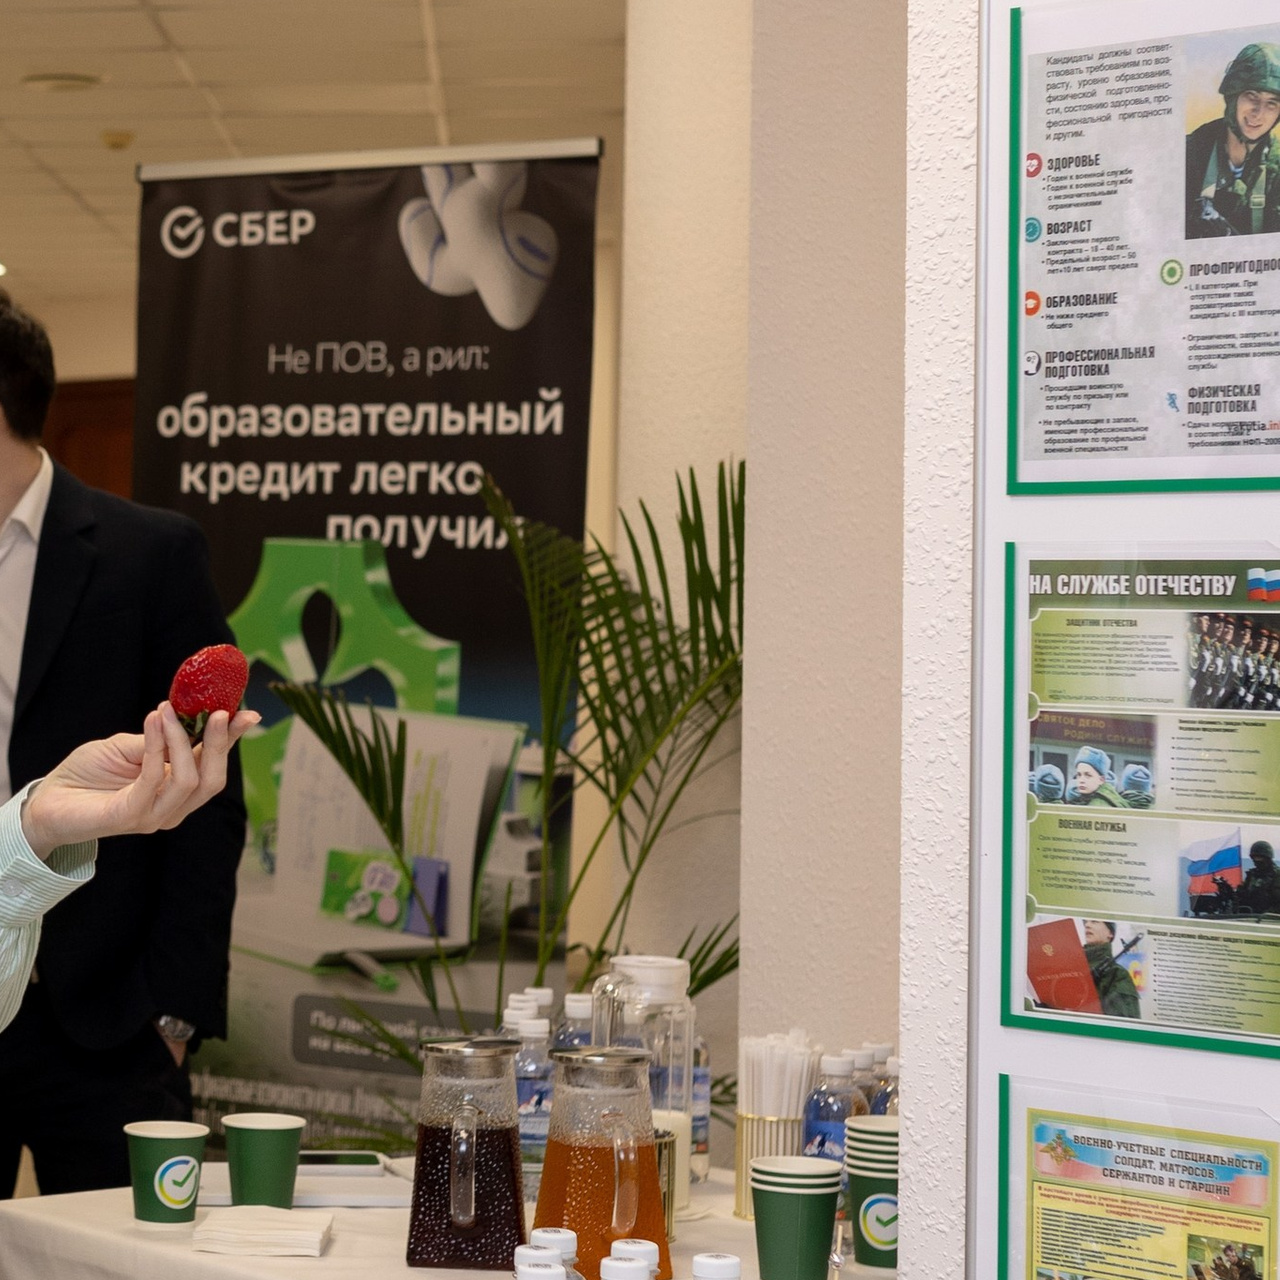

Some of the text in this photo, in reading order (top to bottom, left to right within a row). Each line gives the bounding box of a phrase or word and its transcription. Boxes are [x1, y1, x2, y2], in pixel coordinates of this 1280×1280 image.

[1046, 54, 1093, 65] Кандидаты
[1098, 49, 1132, 60] должны
[1046, 67, 1083, 78] ствовать
[1086, 60, 1140, 74] требованиям
[1154, 56, 1172, 64] воз-
[1078, 76, 1109, 89] уровню
[1046, 82, 1172, 104] физической подготовленно-
[1064, 103, 1108, 113] состоянию
[1154, 94, 1172, 104] про-
[1046, 107, 1172, 129] фессиональной пригодности
[1053, 130, 1085, 141] другим.
[1047, 154, 1101, 172] ЗДОРОВЬЕ
[212, 209, 316, 248] СБЕР
[1047, 220, 1092, 235] ВОЗРАСТ
[1046, 292, 1118, 308] ОБРАЗОВАНИЕ
[268, 340, 490, 379] Не ПОВ, а рил:
[1045, 346, 1155, 363] ПРОФЕССИОНАЛЬНАЯ
[1045, 364, 1110, 379] ПОДГОТОВКА
[1188, 384, 1261, 398] ФИЗИЧЕСКАЯ
[157, 386, 565, 448] образовательный
[1188, 400, 1257, 416] ПОДГОТОВКА
[181, 460, 486, 504] кредит легко
[1029, 574, 1237, 596] НА СЛУЖБЕ ОТЕЧЕСТВУ
[1058, 819, 1127, 833] ВОЕННАЯ СЛУЖБА
[1073, 1134, 1262, 1171] ВОЕННО-УЧЕТНЫЕ СПЕЦИАЛЬНОСТИ
[1102, 1168, 1165, 1186] СЕРЖАНТОВ
[1179, 1181, 1230, 1196] СТАРШИН
